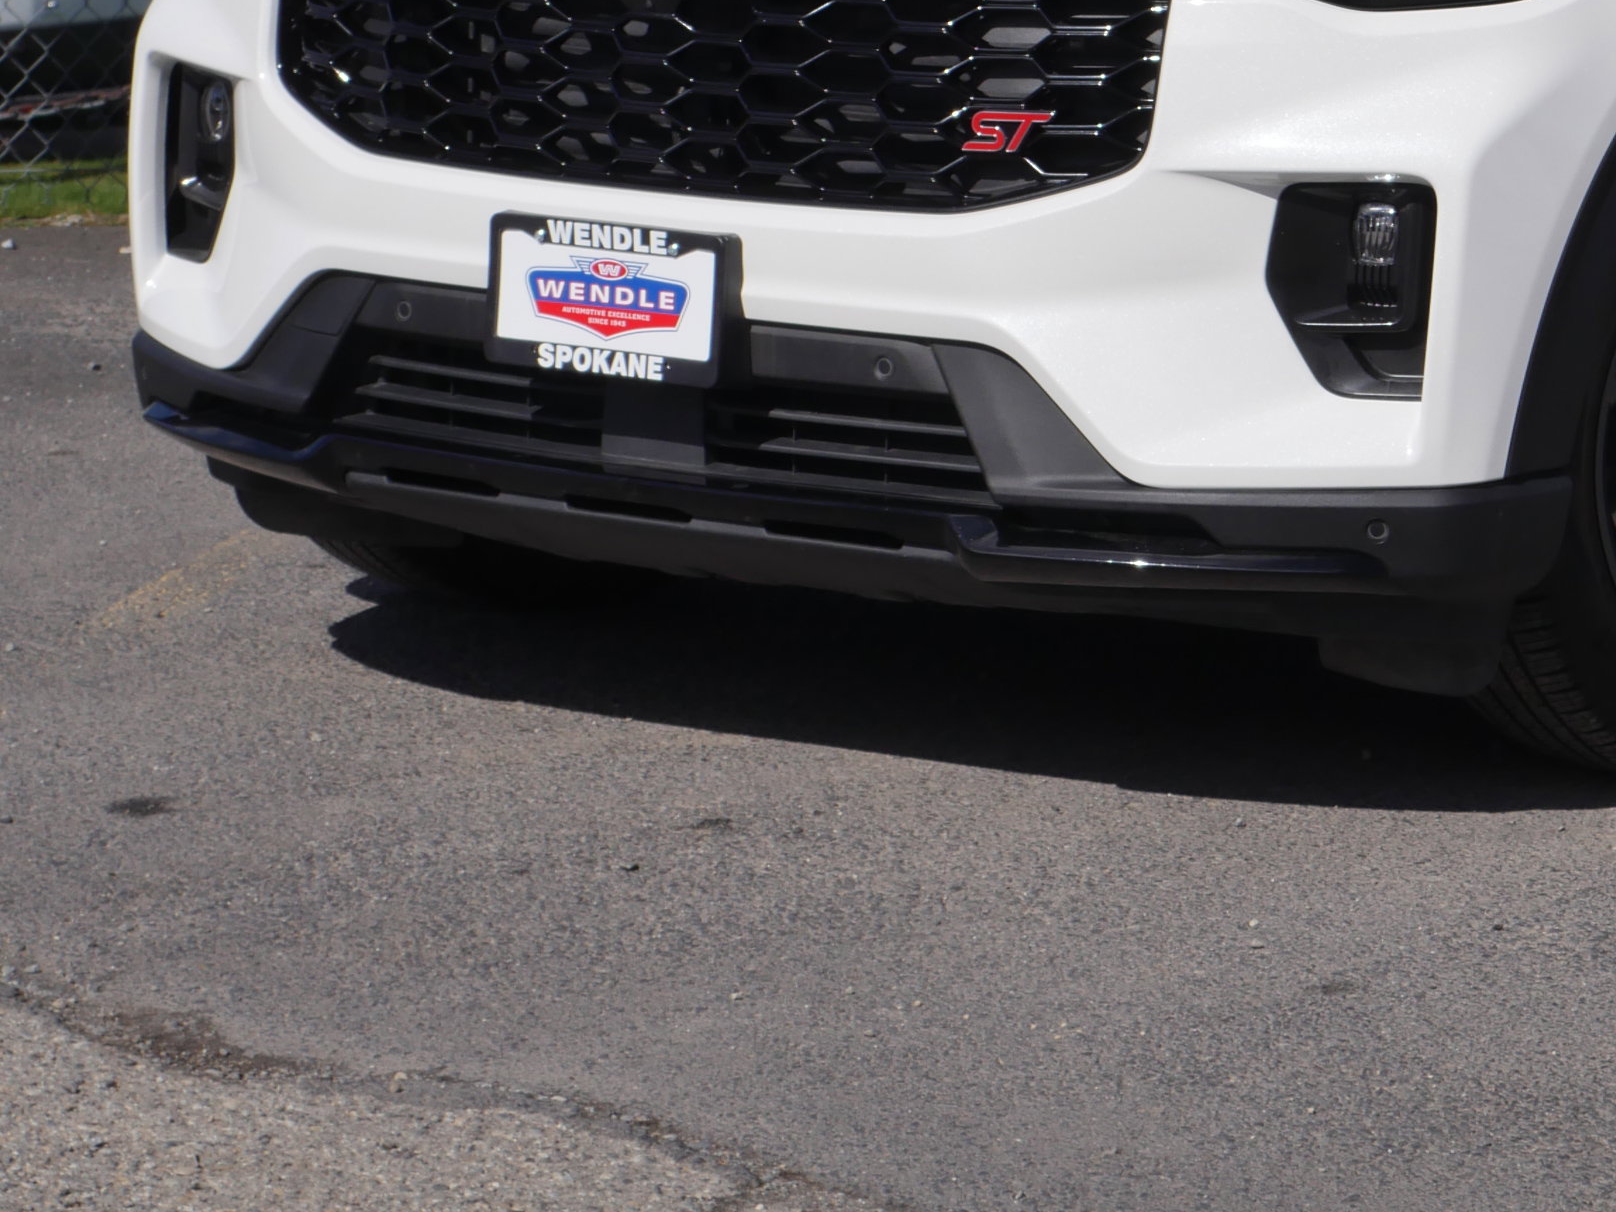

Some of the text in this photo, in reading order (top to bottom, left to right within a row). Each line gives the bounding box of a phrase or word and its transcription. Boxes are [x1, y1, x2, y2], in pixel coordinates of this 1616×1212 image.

[962, 111, 1053, 152] ST
[547, 219, 669, 255] WENDLE
[537, 278, 675, 311] WENDLE
[561, 306, 651, 322] AUTOMOTIVE EXCELLENCE
[587, 317, 609, 326] SINCE
[537, 343, 665, 381] SPOKANE
